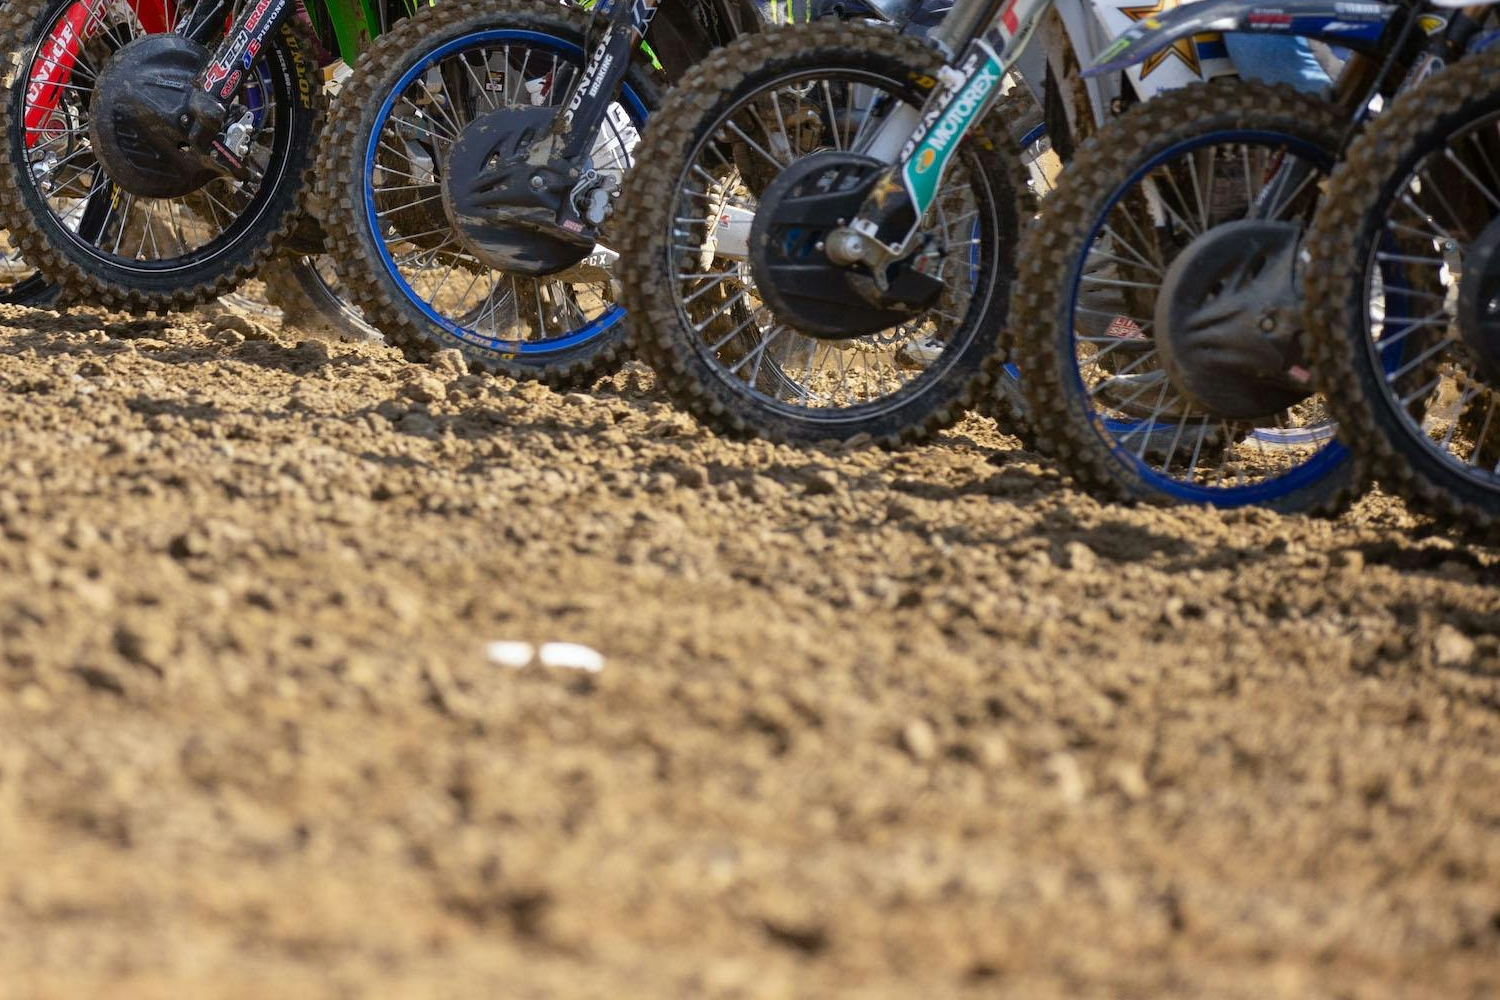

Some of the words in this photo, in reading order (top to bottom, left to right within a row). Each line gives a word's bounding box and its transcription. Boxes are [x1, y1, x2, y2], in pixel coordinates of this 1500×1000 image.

[25, 21, 74, 108] UNLOP
[242, 37, 261, 71] JE
[563, 20, 615, 125] DUNLOP
[589, 54, 615, 99] BRAKING
[927, 66, 999, 150] MOTOREX
